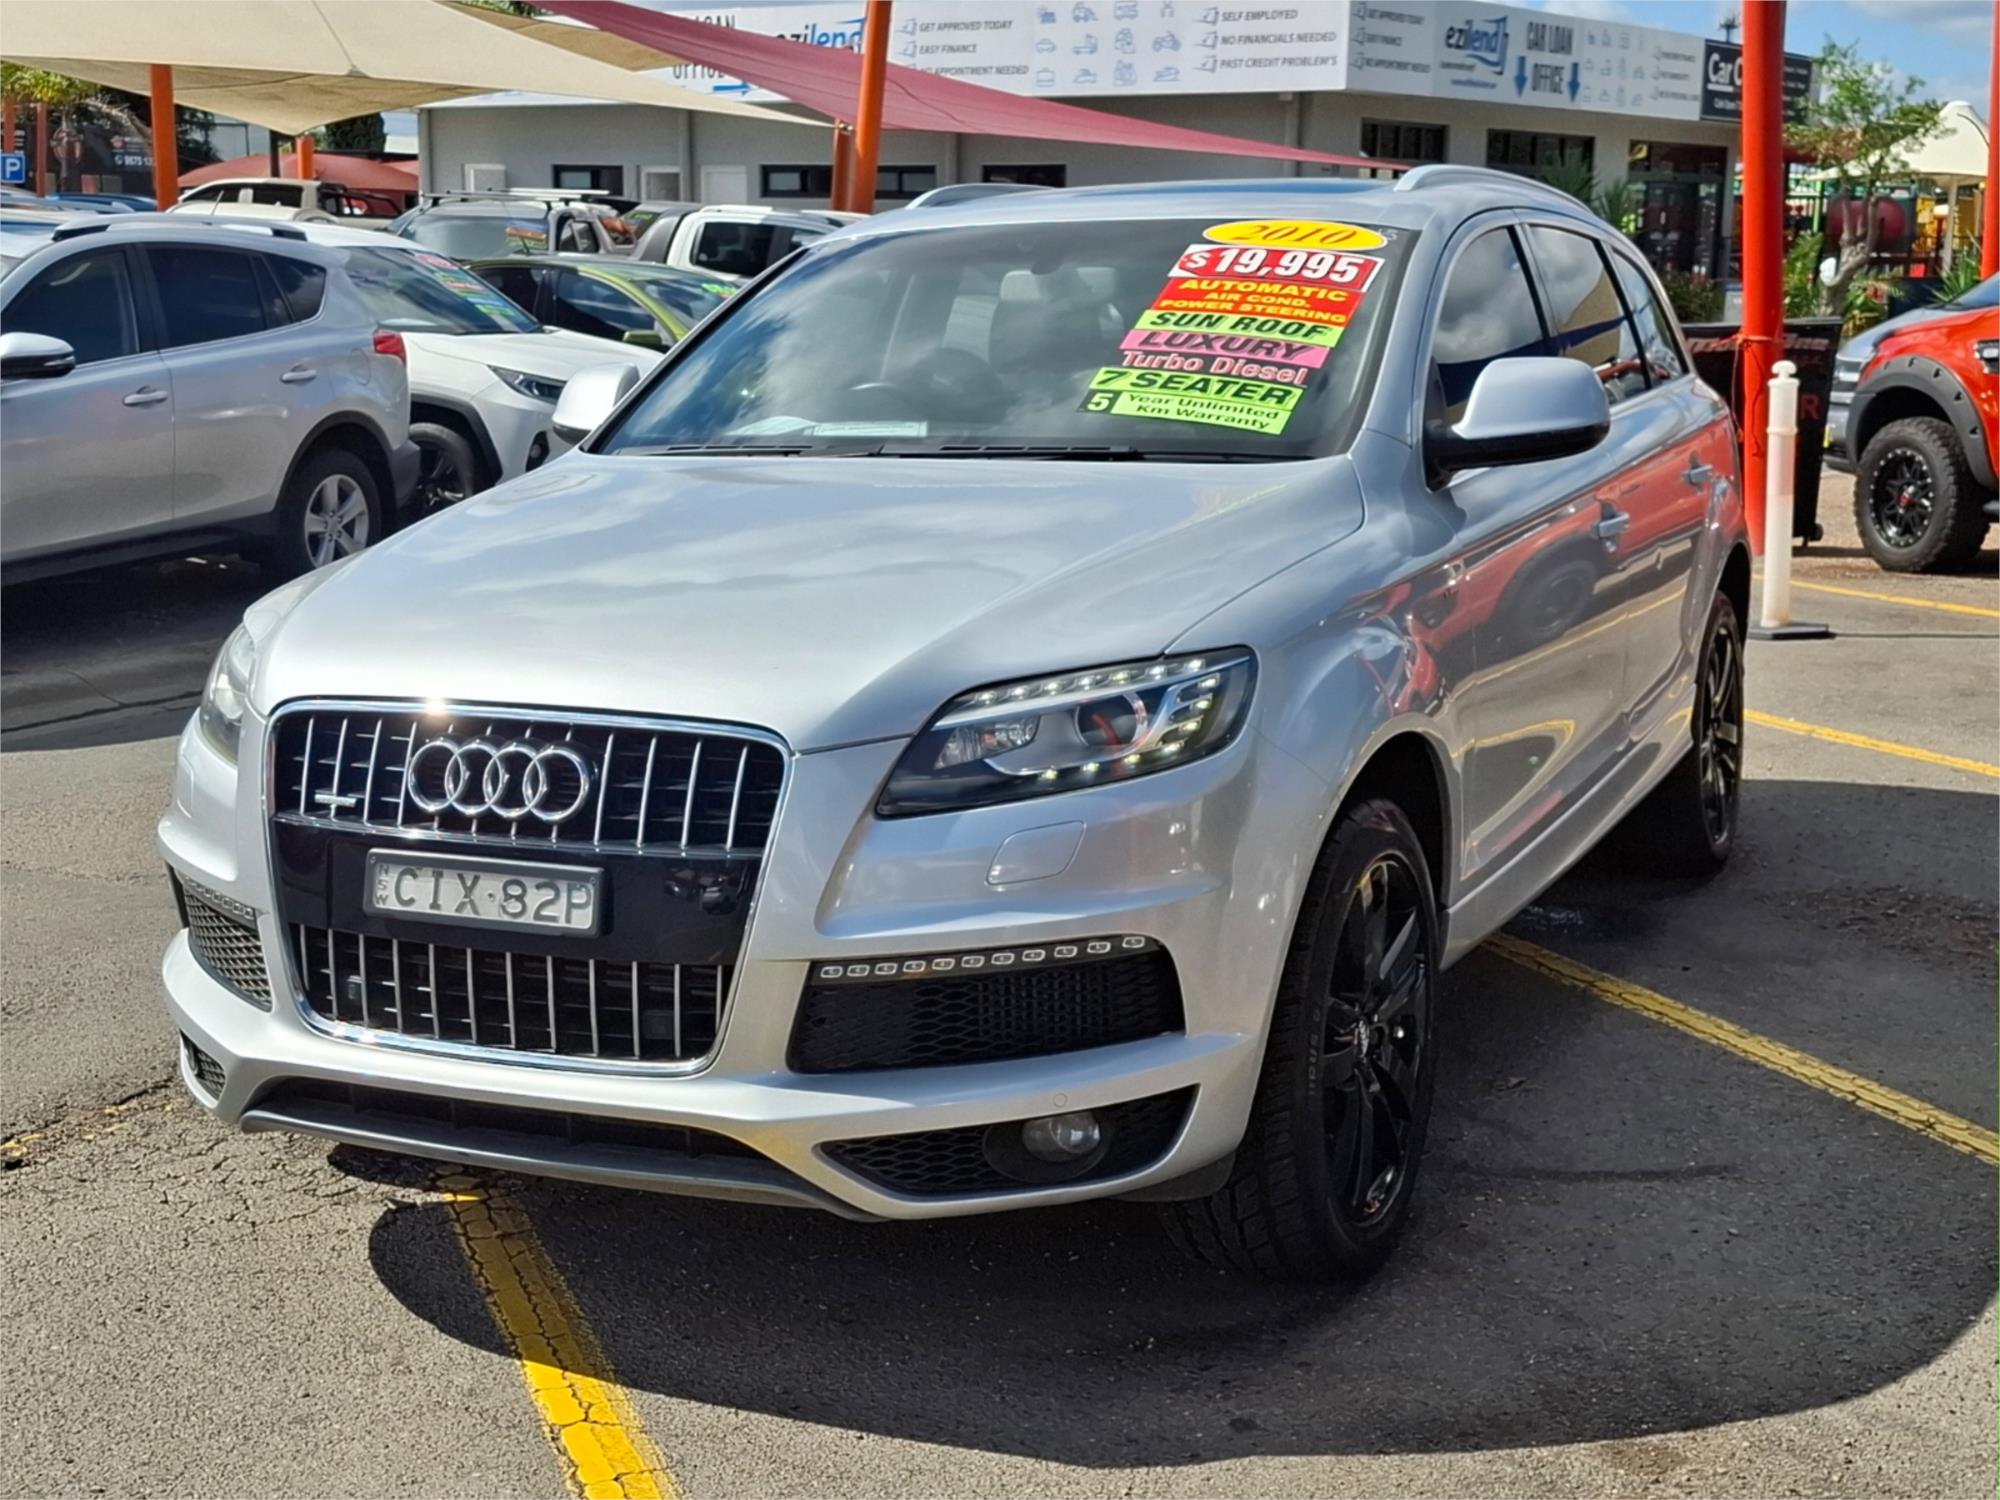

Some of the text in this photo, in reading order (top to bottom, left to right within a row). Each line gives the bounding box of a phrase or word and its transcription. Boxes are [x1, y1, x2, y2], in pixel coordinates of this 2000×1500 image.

[937, 21, 981, 31] APPROVED
[984, 20, 1013, 30] TODAY
[1222, 10, 1298, 21] SELF EMPLOYED
[919, 44, 977, 54] EASY FINANCE
[1222, 32, 1337, 45] NO FINANCIALS NEEDED
[995, 65, 1029, 74] NEEDED
[1220, 58, 1242, 69] PAST
[1245, 57, 1278, 68] CREDIT
[1708, 52, 1733, 84] Car
[5, 158, 20, 179] P
[1235, 224, 1357, 246] 2010
[1179, 279, 1350, 302] AUTOMATIC
[1204, 292, 1311, 308] AIR COND.
[1160, 299, 1346, 323] POWER STEERING
[1150, 312, 1331, 339] SUN ROOF
[1138, 332, 1315, 359] LUXURY
[1122, 350, 1310, 385] Turbo Diesel
[1096, 370, 1293, 406] 7 SEATER
[1087, 392, 1280, 420] 5 Year Unlimited
[1136, 404, 1271, 429] Km Warranty
[375, 864, 390, 906] NSW
